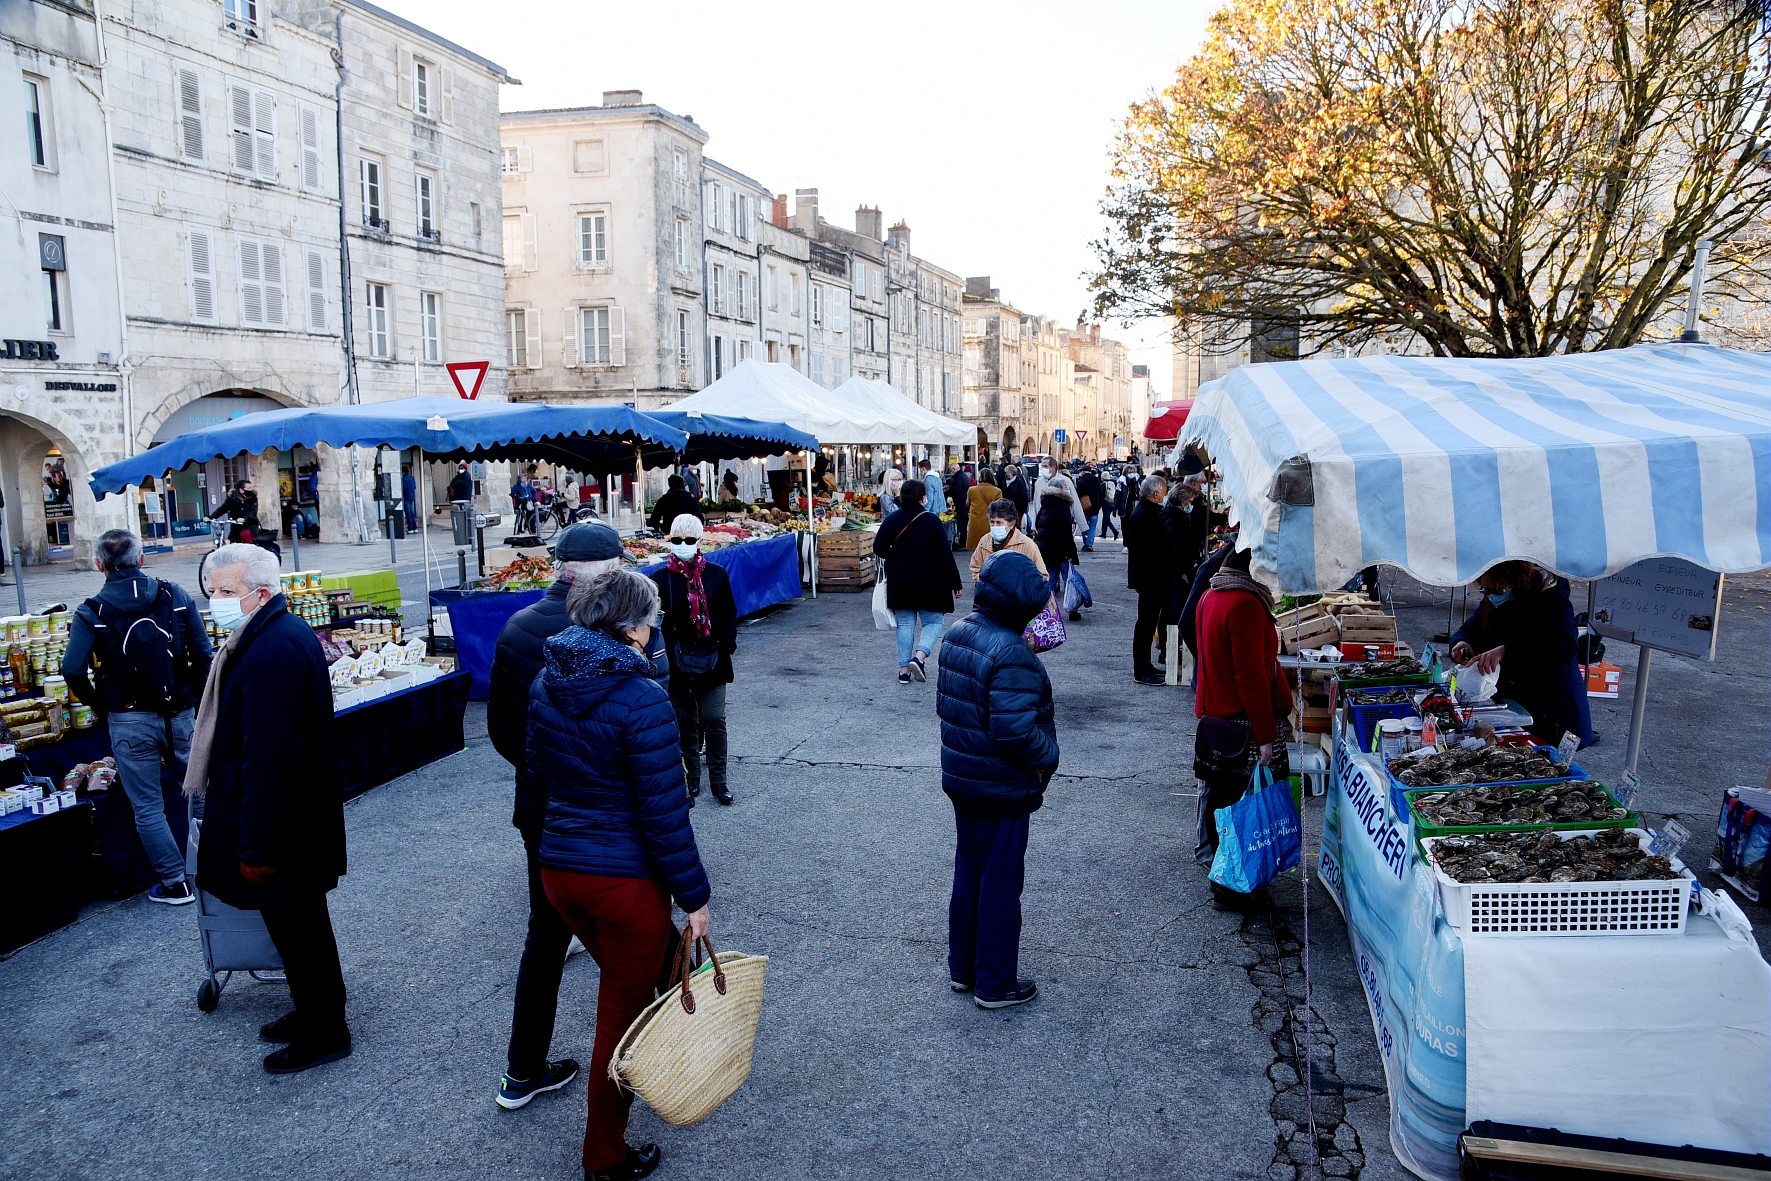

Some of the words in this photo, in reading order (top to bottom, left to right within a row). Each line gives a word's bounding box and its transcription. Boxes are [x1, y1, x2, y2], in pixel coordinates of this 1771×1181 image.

[45, 381, 117, 393] DESVALLOIS
[1654, 583, 1705, 599] EXPEDITEUR
[1652, 626, 1690, 646] FOURAS
[1416, 1014, 1459, 1058] OURAS
